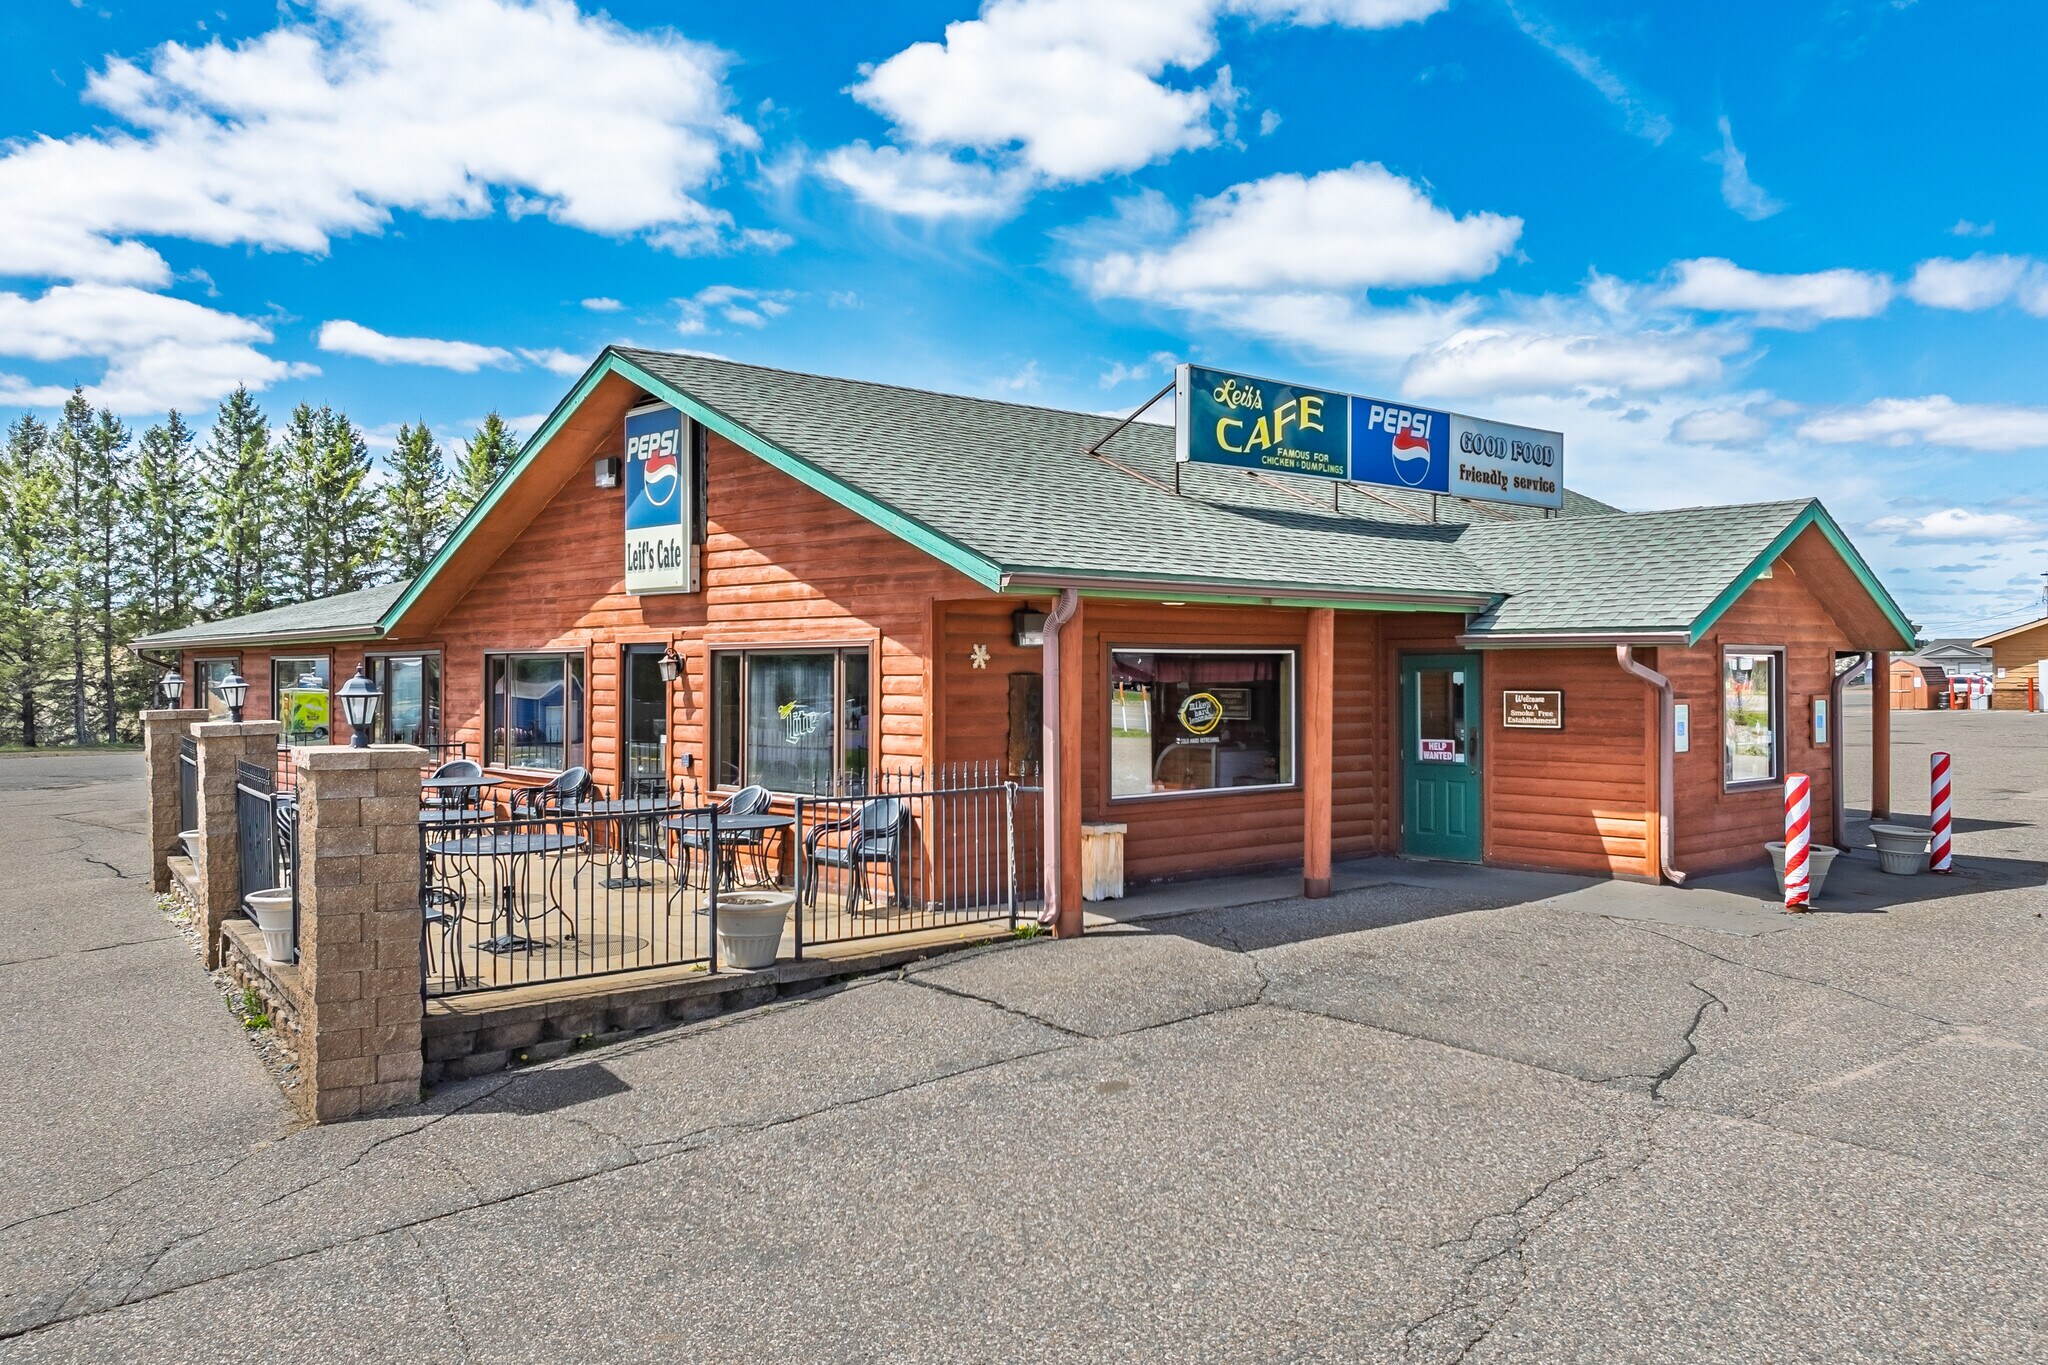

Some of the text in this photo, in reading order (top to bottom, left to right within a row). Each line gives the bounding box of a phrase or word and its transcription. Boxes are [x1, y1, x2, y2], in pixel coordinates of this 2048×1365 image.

[1216, 395, 1324, 454] CAFE
[1368, 404, 1432, 439] PEPSI
[627, 428, 679, 462] PEPSI
[1277, 447, 1329, 463] FAMOUS FOR
[1460, 431, 1555, 468] GOOD FOOD
[1261, 455, 1295, 468] CHICKEN
[1301, 460, 1344, 475] DUMPLINGS
[1513, 476, 1556, 493] service
[627, 538, 681, 571] Leif's Cafe
[785, 710, 816, 744] Lite
[1423, 751, 1452, 760] WANTED
[1428, 742, 1447, 750] HELP
